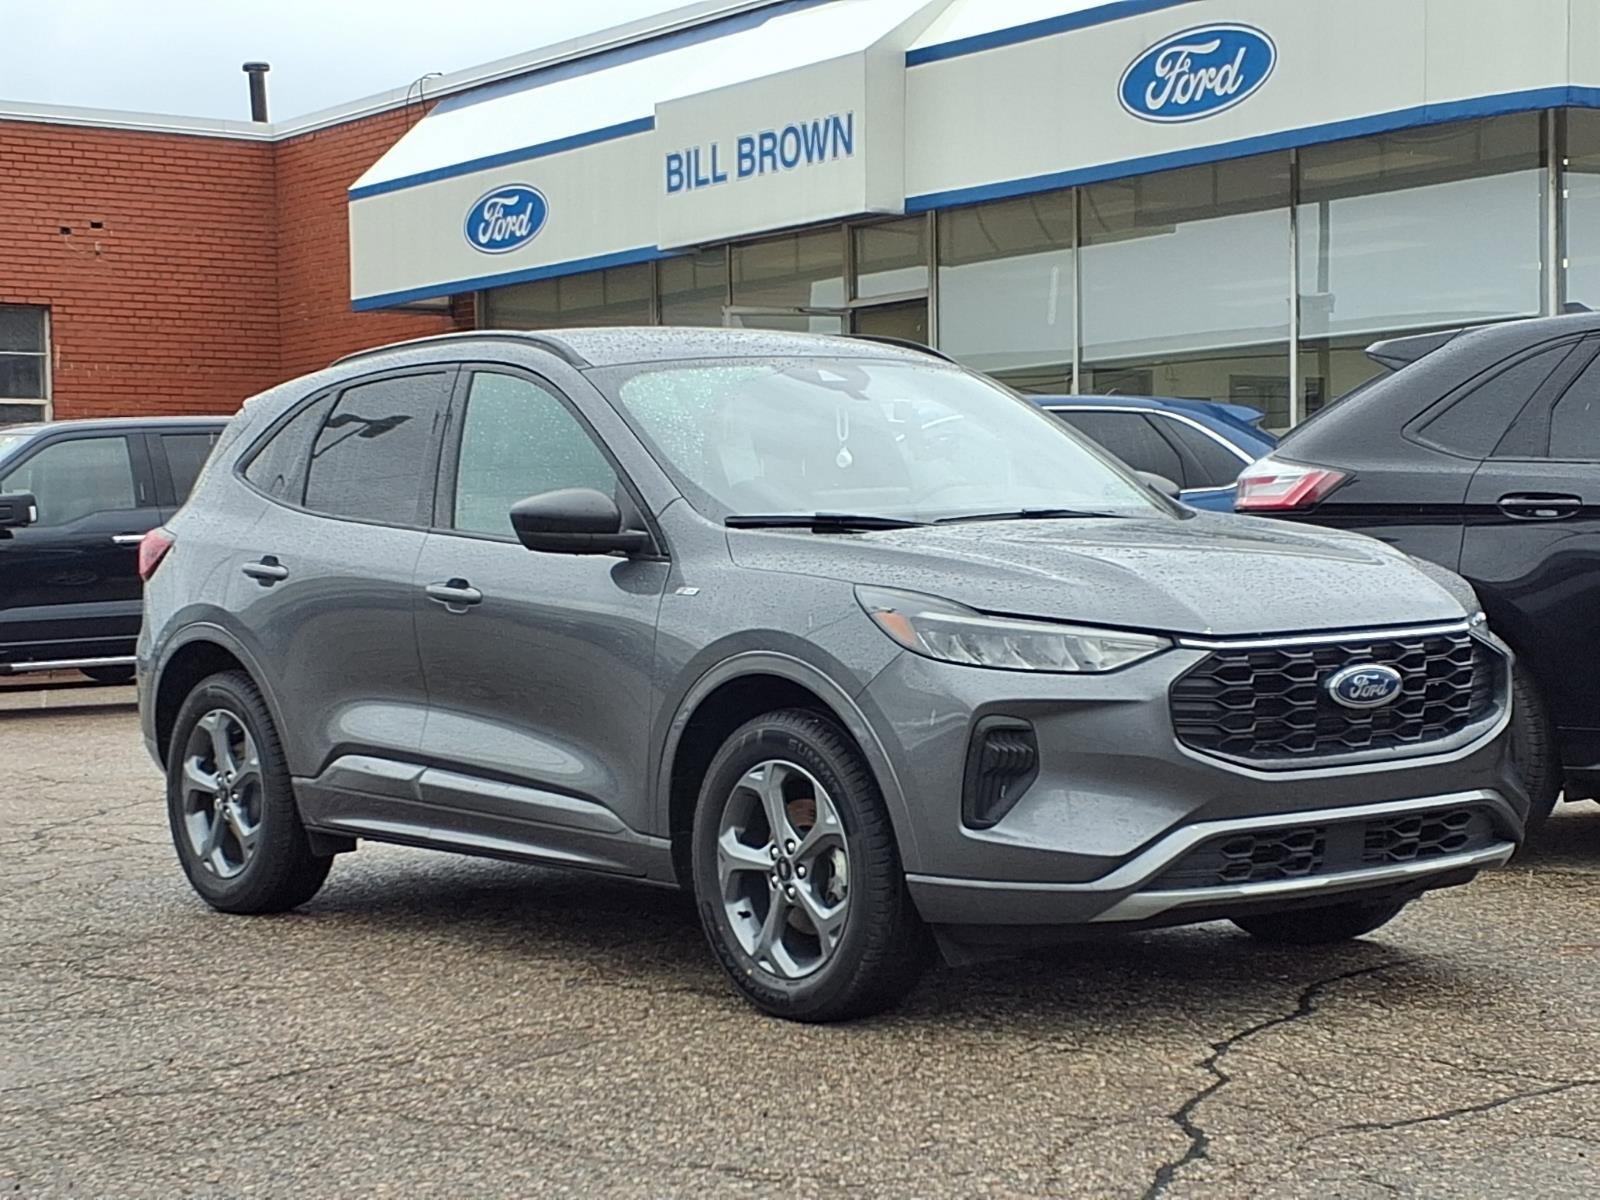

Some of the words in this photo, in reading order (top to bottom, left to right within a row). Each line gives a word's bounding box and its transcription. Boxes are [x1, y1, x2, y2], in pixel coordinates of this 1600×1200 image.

[1145, 39, 1247, 110] Ford
[666, 143, 728, 194] BILL
[737, 112, 854, 179] BROWN
[478, 195, 533, 244] Ford
[1349, 674, 1389, 699] Ford
